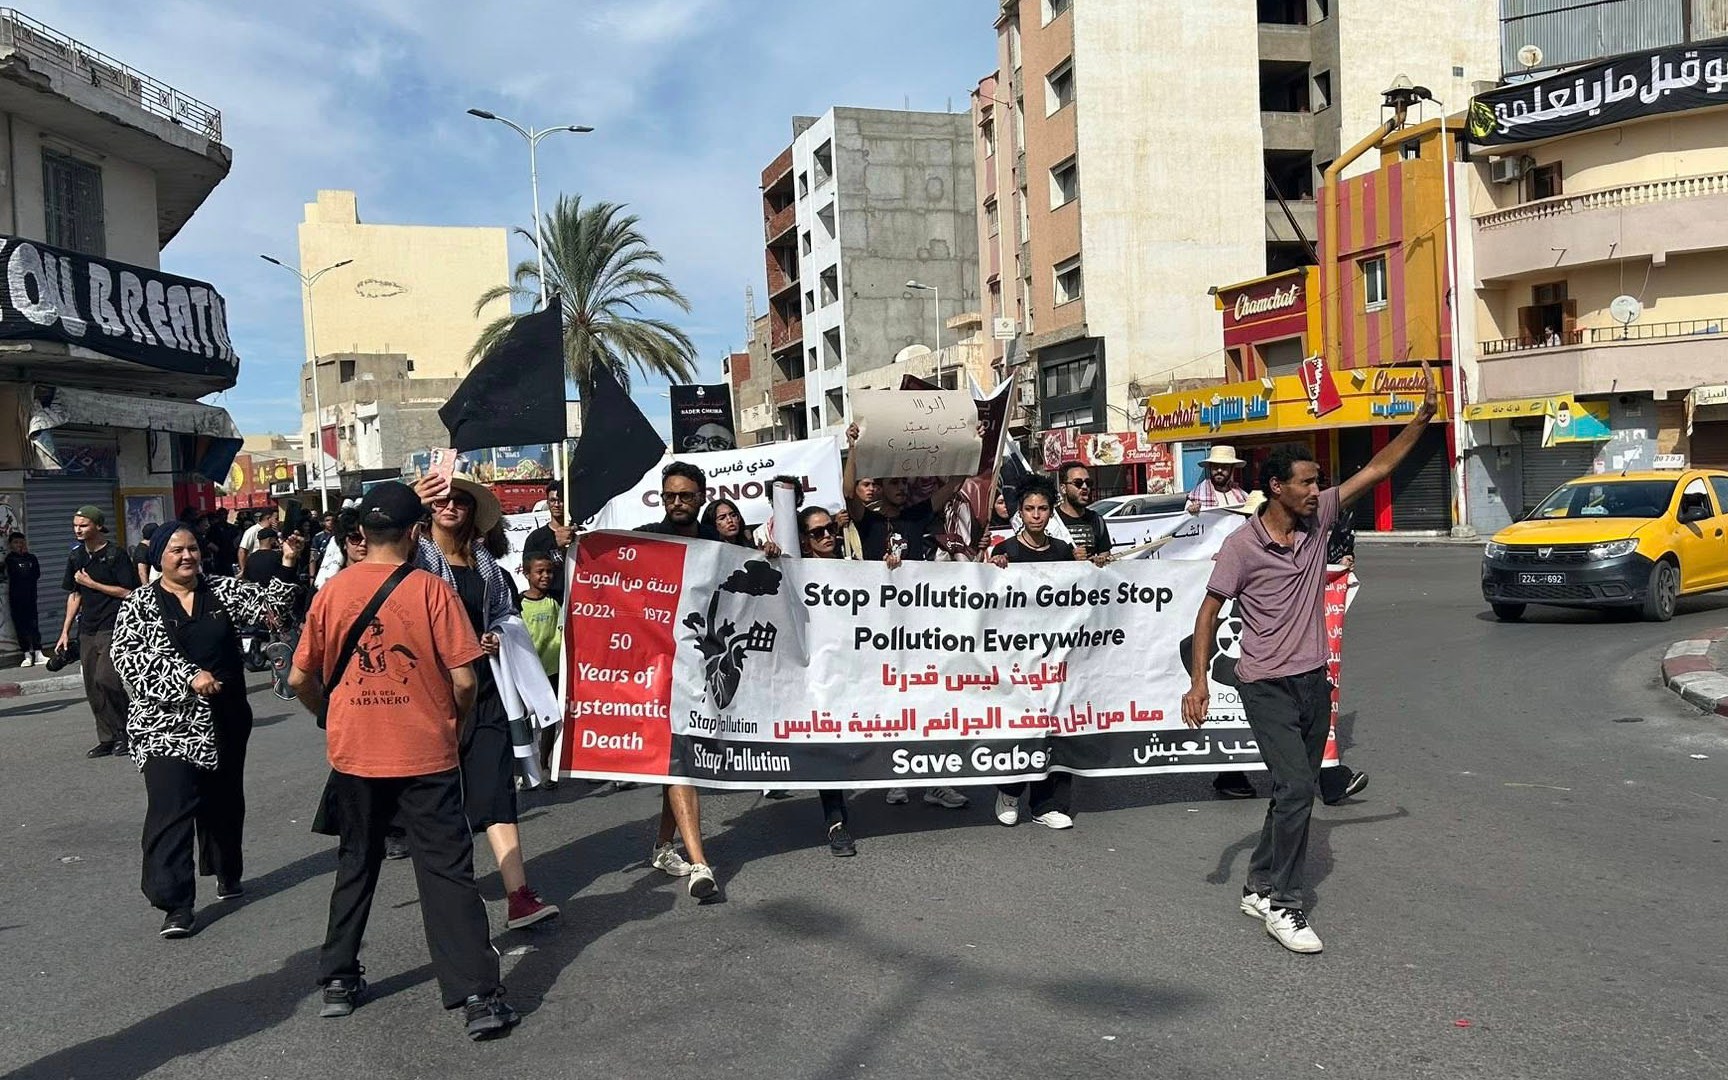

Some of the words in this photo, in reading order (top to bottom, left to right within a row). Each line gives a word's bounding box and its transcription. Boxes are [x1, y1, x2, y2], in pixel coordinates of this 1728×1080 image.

[0, 238, 87, 337] OU
[1234, 283, 1300, 321] Chamchat
[1372, 369, 1427, 393] Chamcha
[1143, 398, 1199, 433] Chamchat
[617, 546, 637, 561] 50
[576, 571, 621, 589] الموت
[621, 577, 643, 592] من
[646, 577, 678, 595] سنة
[1521, 574, 1536, 584] 224
[1547, 574, 1563, 584] 692
[803, 582, 870, 616] Stop
[880, 582, 999, 610] Pollution
[1004, 585, 1027, 608] in
[1036, 582, 1110, 608] Gabes
[1116, 581, 1173, 612] Stop
[572, 602, 611, 618] 2022
[642, 607, 672, 624] 1972
[608, 633, 632, 650] 50
[854, 626, 975, 652] Pollution
[984, 624, 1126, 657] Everywhere
[578, 661, 629, 684] Years
[633, 665, 655, 689] of
[881, 663, 939, 693] قدرنا
[944, 665, 1000, 691] ليس
[350, 695, 410, 706] SABANERO
[569, 698, 668, 719] ystematic
[1130, 700, 1164, 722] معا
[689, 710, 717, 735] Stop
[773, 709, 842, 739] بقابس
[923, 706, 1001, 737] الجرائم
[1064, 701, 1093, 733] أجل
[1096, 706, 1124, 730] من
[581, 729, 644, 751] Death
[1134, 733, 1211, 764] نعيش
[694, 743, 723, 774] Stop
[725, 748, 791, 772] Pollution
[892, 748, 962, 775] Save
